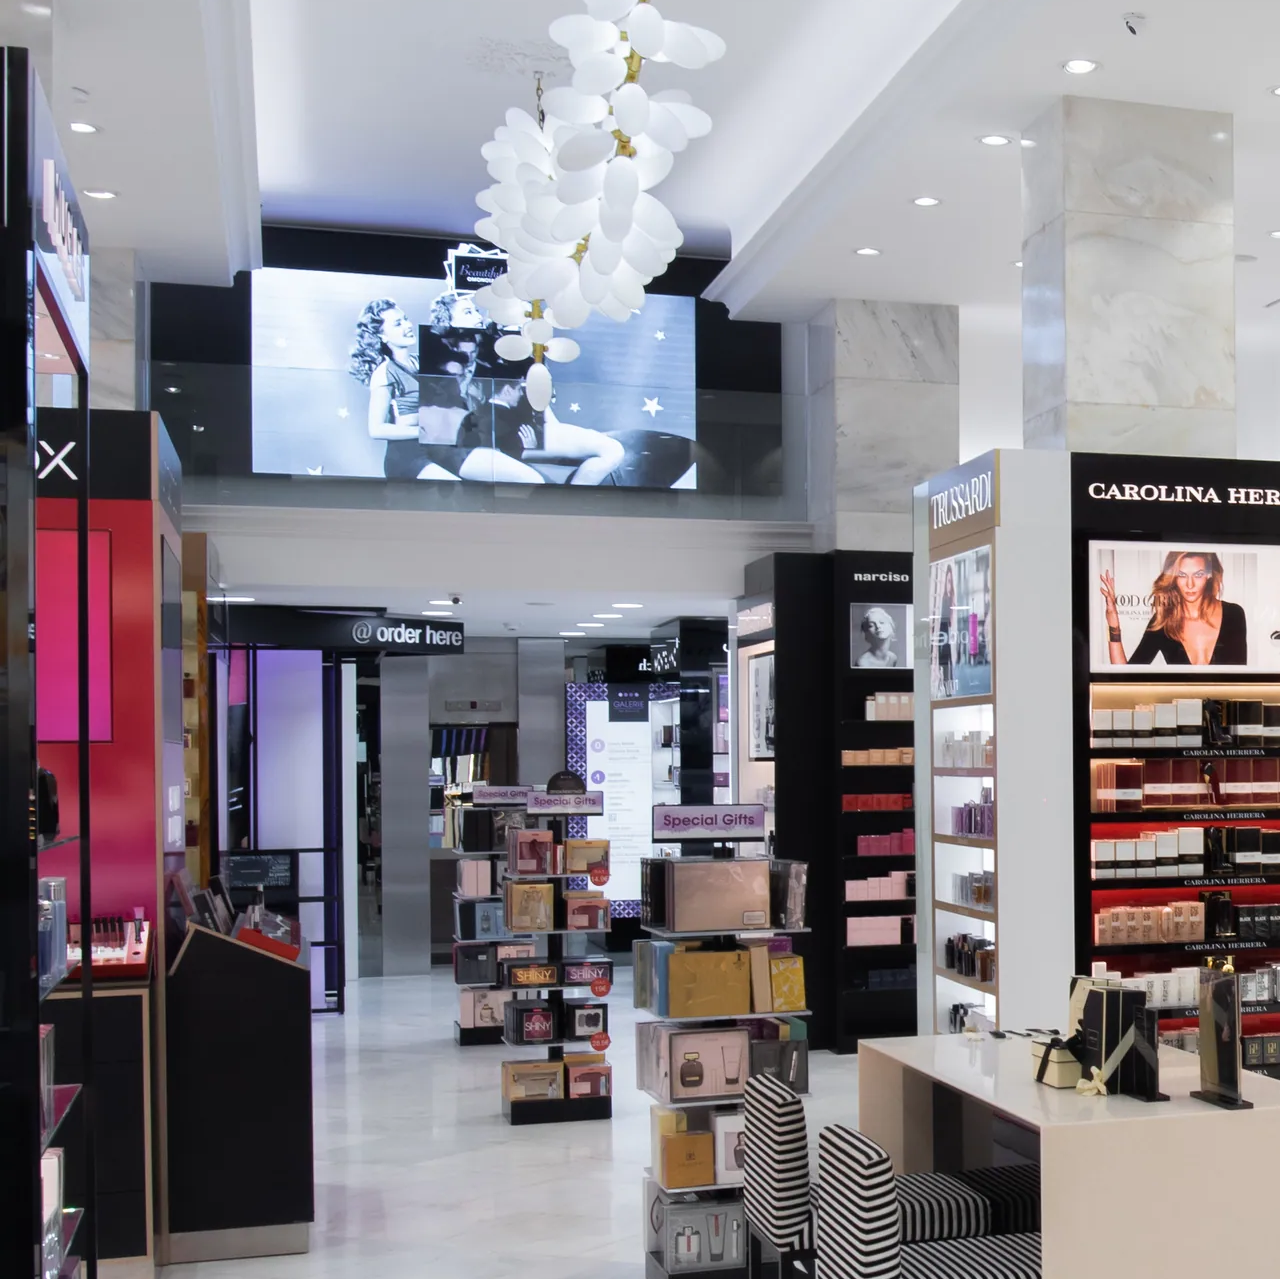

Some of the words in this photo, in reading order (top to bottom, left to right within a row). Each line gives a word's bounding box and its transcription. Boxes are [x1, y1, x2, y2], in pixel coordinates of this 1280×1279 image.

[1088, 482, 1222, 503] CAROLINA
[930, 471, 992, 529] TRUSSARDI
[854, 571, 910, 582] narciso
[1112, 594, 1141, 607] OOD
[352, 621, 372, 644] @
[376, 623, 422, 644] order
[425, 625, 463, 646] here
[613, 700, 645, 708] GALERIE
[534, 797, 571, 807] Special
[574, 796, 597, 806] Gifts
[663, 813, 718, 829] Special
[722, 813, 755, 825] Gifts
[1183, 813, 1225, 821] CAROLINA
[1226, 812, 1266, 820] HERRERA
[1228, 942, 1268, 950] HERRERA
[516, 969, 552, 982] SHINY
[570, 968, 605, 979] SHINY
[525, 1021, 552, 1032] SHINY
